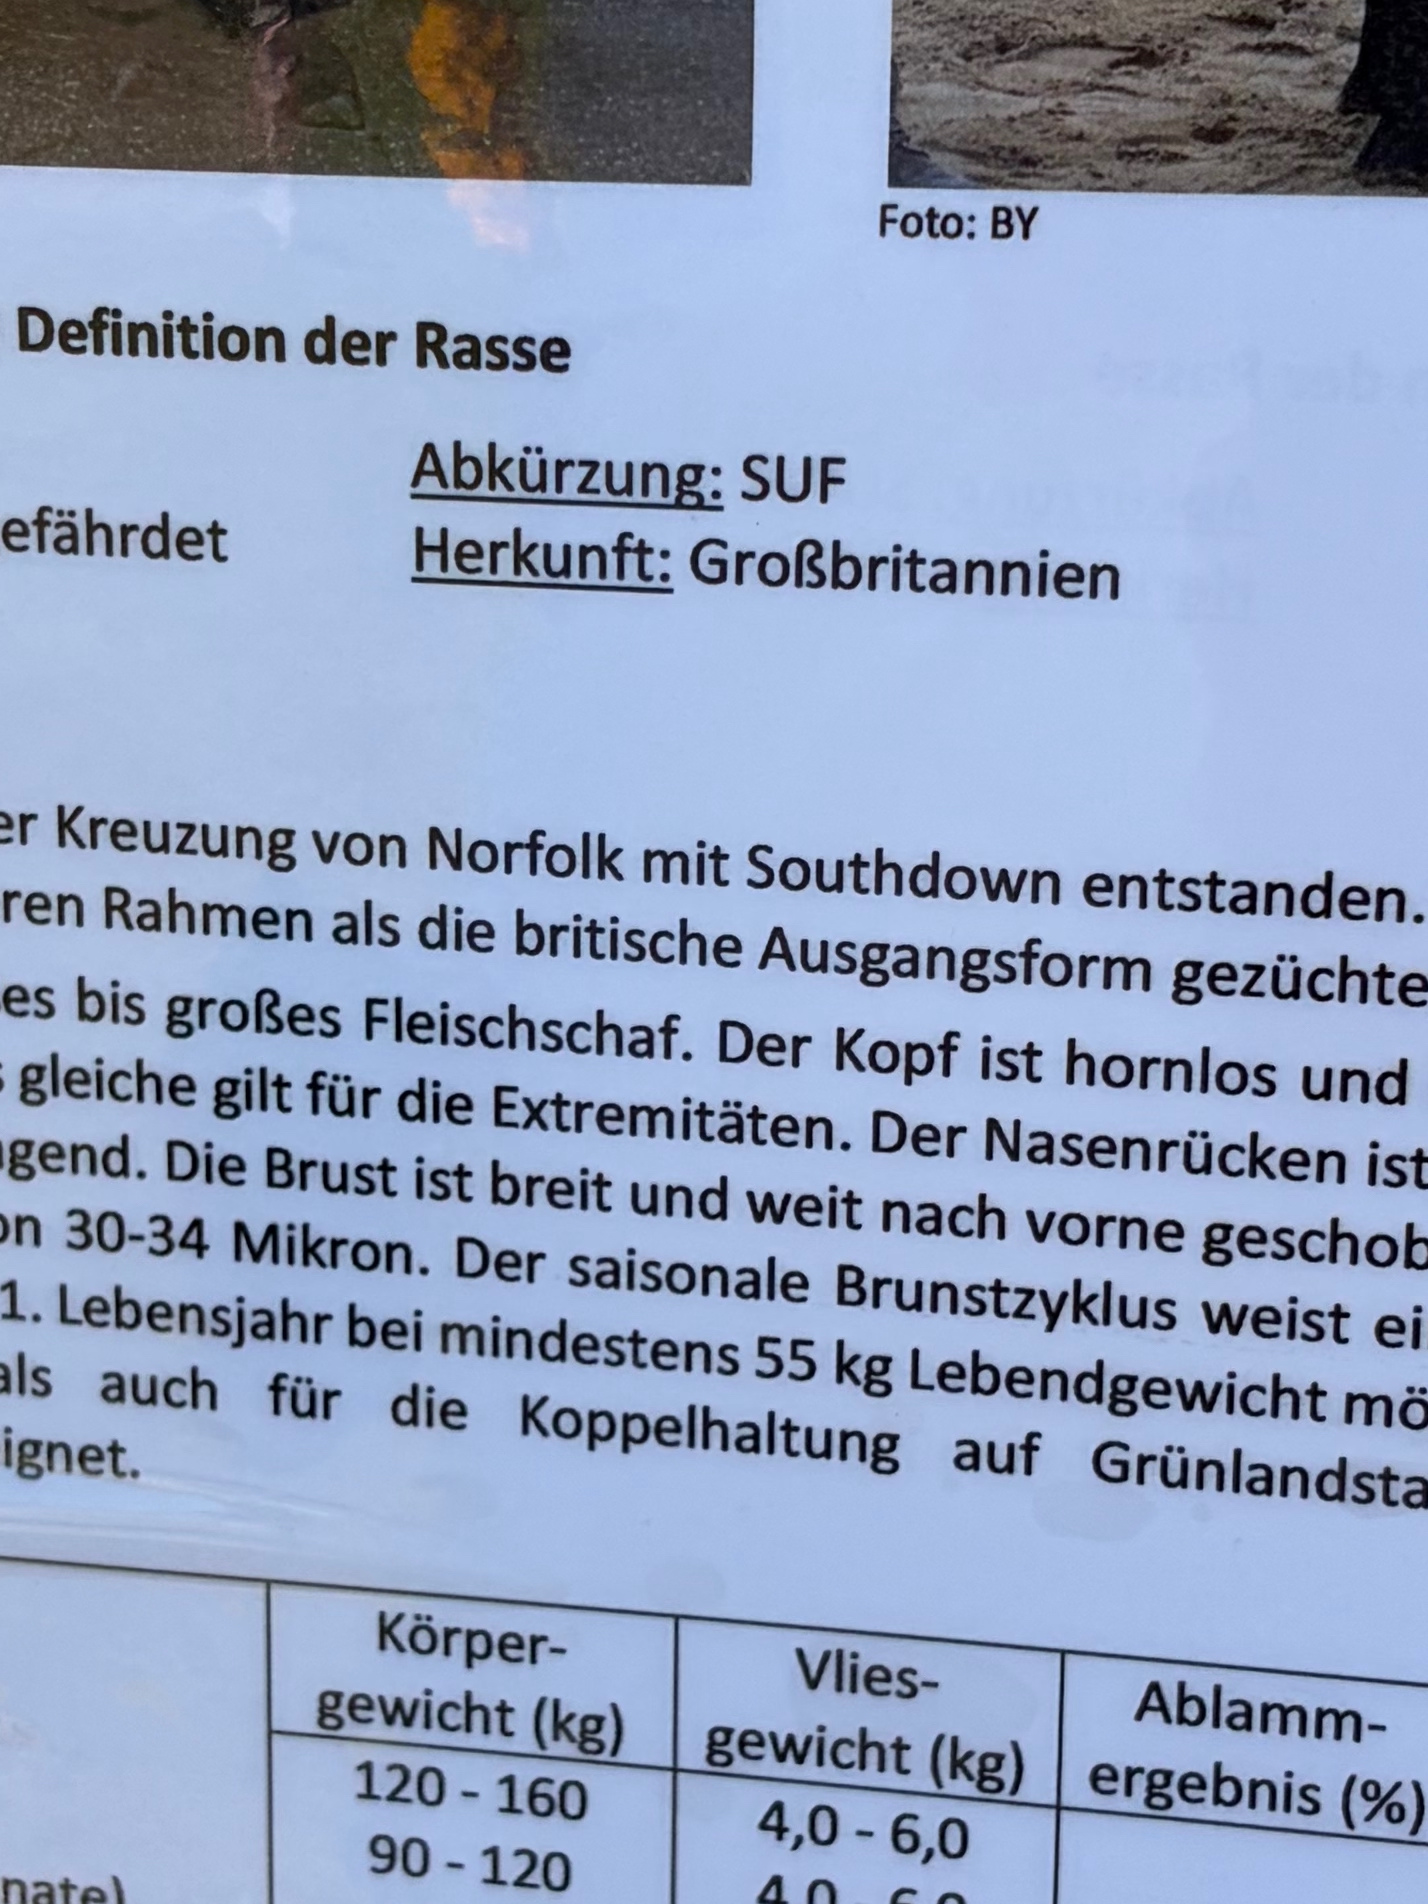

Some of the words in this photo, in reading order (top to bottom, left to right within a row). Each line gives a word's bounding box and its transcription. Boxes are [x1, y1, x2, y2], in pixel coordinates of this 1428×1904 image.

[879, 202, 977, 241] Foto:
[990, 205, 1040, 242] BY
[16, 305, 287, 364] Definition
[303, 314, 399, 368] der
[415, 320, 572, 374] Rasse
[409, 439, 725, 513] Abkürzung:
[740, 453, 847, 505] SUF
[414, 525, 671, 584] Herkunft:
[689, 537, 1121, 601] Großbritannien
[56, 803, 297, 874] Kreuzung
[311, 829, 407, 869] von
[428, 825, 625, 882] Norfolk
[643, 839, 731, 888] mit
[746, 843, 1061, 906] Southdown
[1082, 867, 1425, 925] entstanden.
[103, 885, 314, 943] Rahmen
[331, 898, 401, 948] als
[417, 903, 496, 954] die
[515, 907, 743, 969] britische
[757, 925, 1152, 994] Ausgangsform
[76, 975, 146, 1027] bis
[165, 987, 342, 1040] großes
[364, 995, 693, 1062] Fleischschaf.
[718, 1019, 813, 1069] Der
[835, 1026, 962, 1087] Kopf
[980, 1034, 1044, 1084] ist
[1065, 1037, 1278, 1099] hornlos
[1301, 1057, 1409, 1107] und
[65, 1207, 211, 1261] 30-34
[233, 1219, 430, 1277] Mikron.
[456, 1235, 547, 1285] Der
[568, 1247, 810, 1304] saisonale
[836, 1263, 1178, 1334] Brunstzyklus
[1200, 1295, 1352, 1346] weist
[378, 1610, 568, 1671] Körper-
[794, 1647, 940, 1700] Vlies-
[316, 1687, 516, 1738] gewicht
[533, 1695, 624, 1758] (kg)
[1133, 1680, 1387, 1744] Ablamm-
[355, 1760, 447, 1808] 120
[497, 1773, 589, 1822] 160
[704, 1724, 912, 1776] gewicht
[929, 1732, 1025, 1797] (kg)
[757, 1799, 840, 1852] 4,0
[890, 1812, 970, 1866] 6,0
[1088, 1760, 1322, 1817] ergebnis
[1341, 1773, 1426, 1837] (%)
